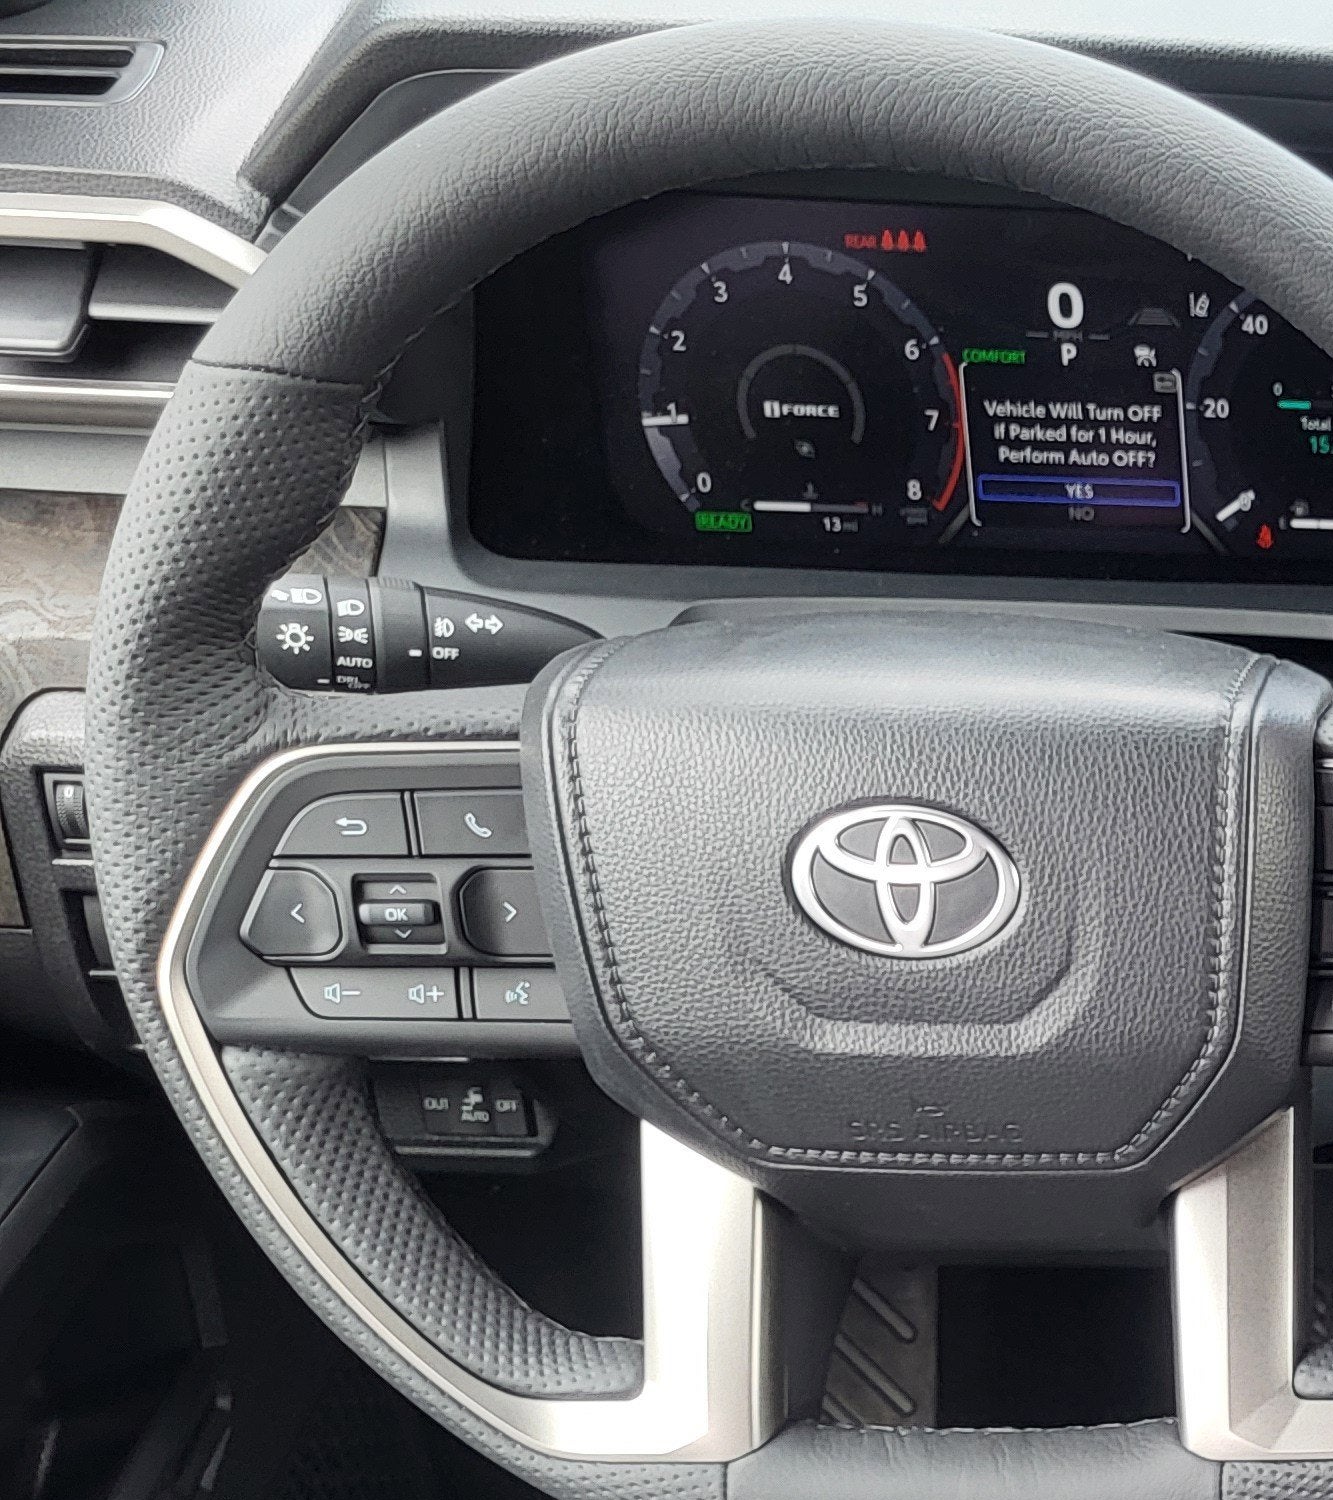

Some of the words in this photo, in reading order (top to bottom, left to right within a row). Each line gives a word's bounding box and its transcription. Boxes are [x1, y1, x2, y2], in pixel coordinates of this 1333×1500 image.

[778, 264, 793, 284] 4
[713, 282, 729, 303] 3
[853, 286, 869, 306] 5
[1048, 282, 1084, 328] 0
[1241, 315, 1268, 335] 40
[671, 331, 686, 351] 2
[904, 340, 919, 360] 6
[961, 348, 1027, 365] COMFORT
[1061, 344, 1077, 366] P
[666, 402, 677, 421] 1
[984, 400, 1045, 419] Vehicle
[1049, 401, 1081, 421] Will
[1084, 403, 1126, 422] Turn
[1130, 405, 1162, 423] OFF
[1204, 399, 1229, 419] 20
[924, 409, 940, 431] 7
[1300, 417, 1330, 433] Total
[994, 424, 1005, 441] If
[1008, 424, 1068, 443] Parked
[1071, 425, 1096, 443] for
[1098, 427, 1104, 444] 1
[1109, 427, 1157, 447] Hour,
[999, 446, 1065, 466] Perform
[1069, 448, 1109, 467] Auto
[1112, 449, 1156, 468] OFF?
[697, 472, 712, 493] 0
[907, 480, 922, 500] 8
[1065, 483, 1094, 500] YES
[823, 516, 841, 532] 13
[337, 656, 373, 668] AUTO
[432, 646, 460, 661] OFF
[384, 908, 409, 922] OK
